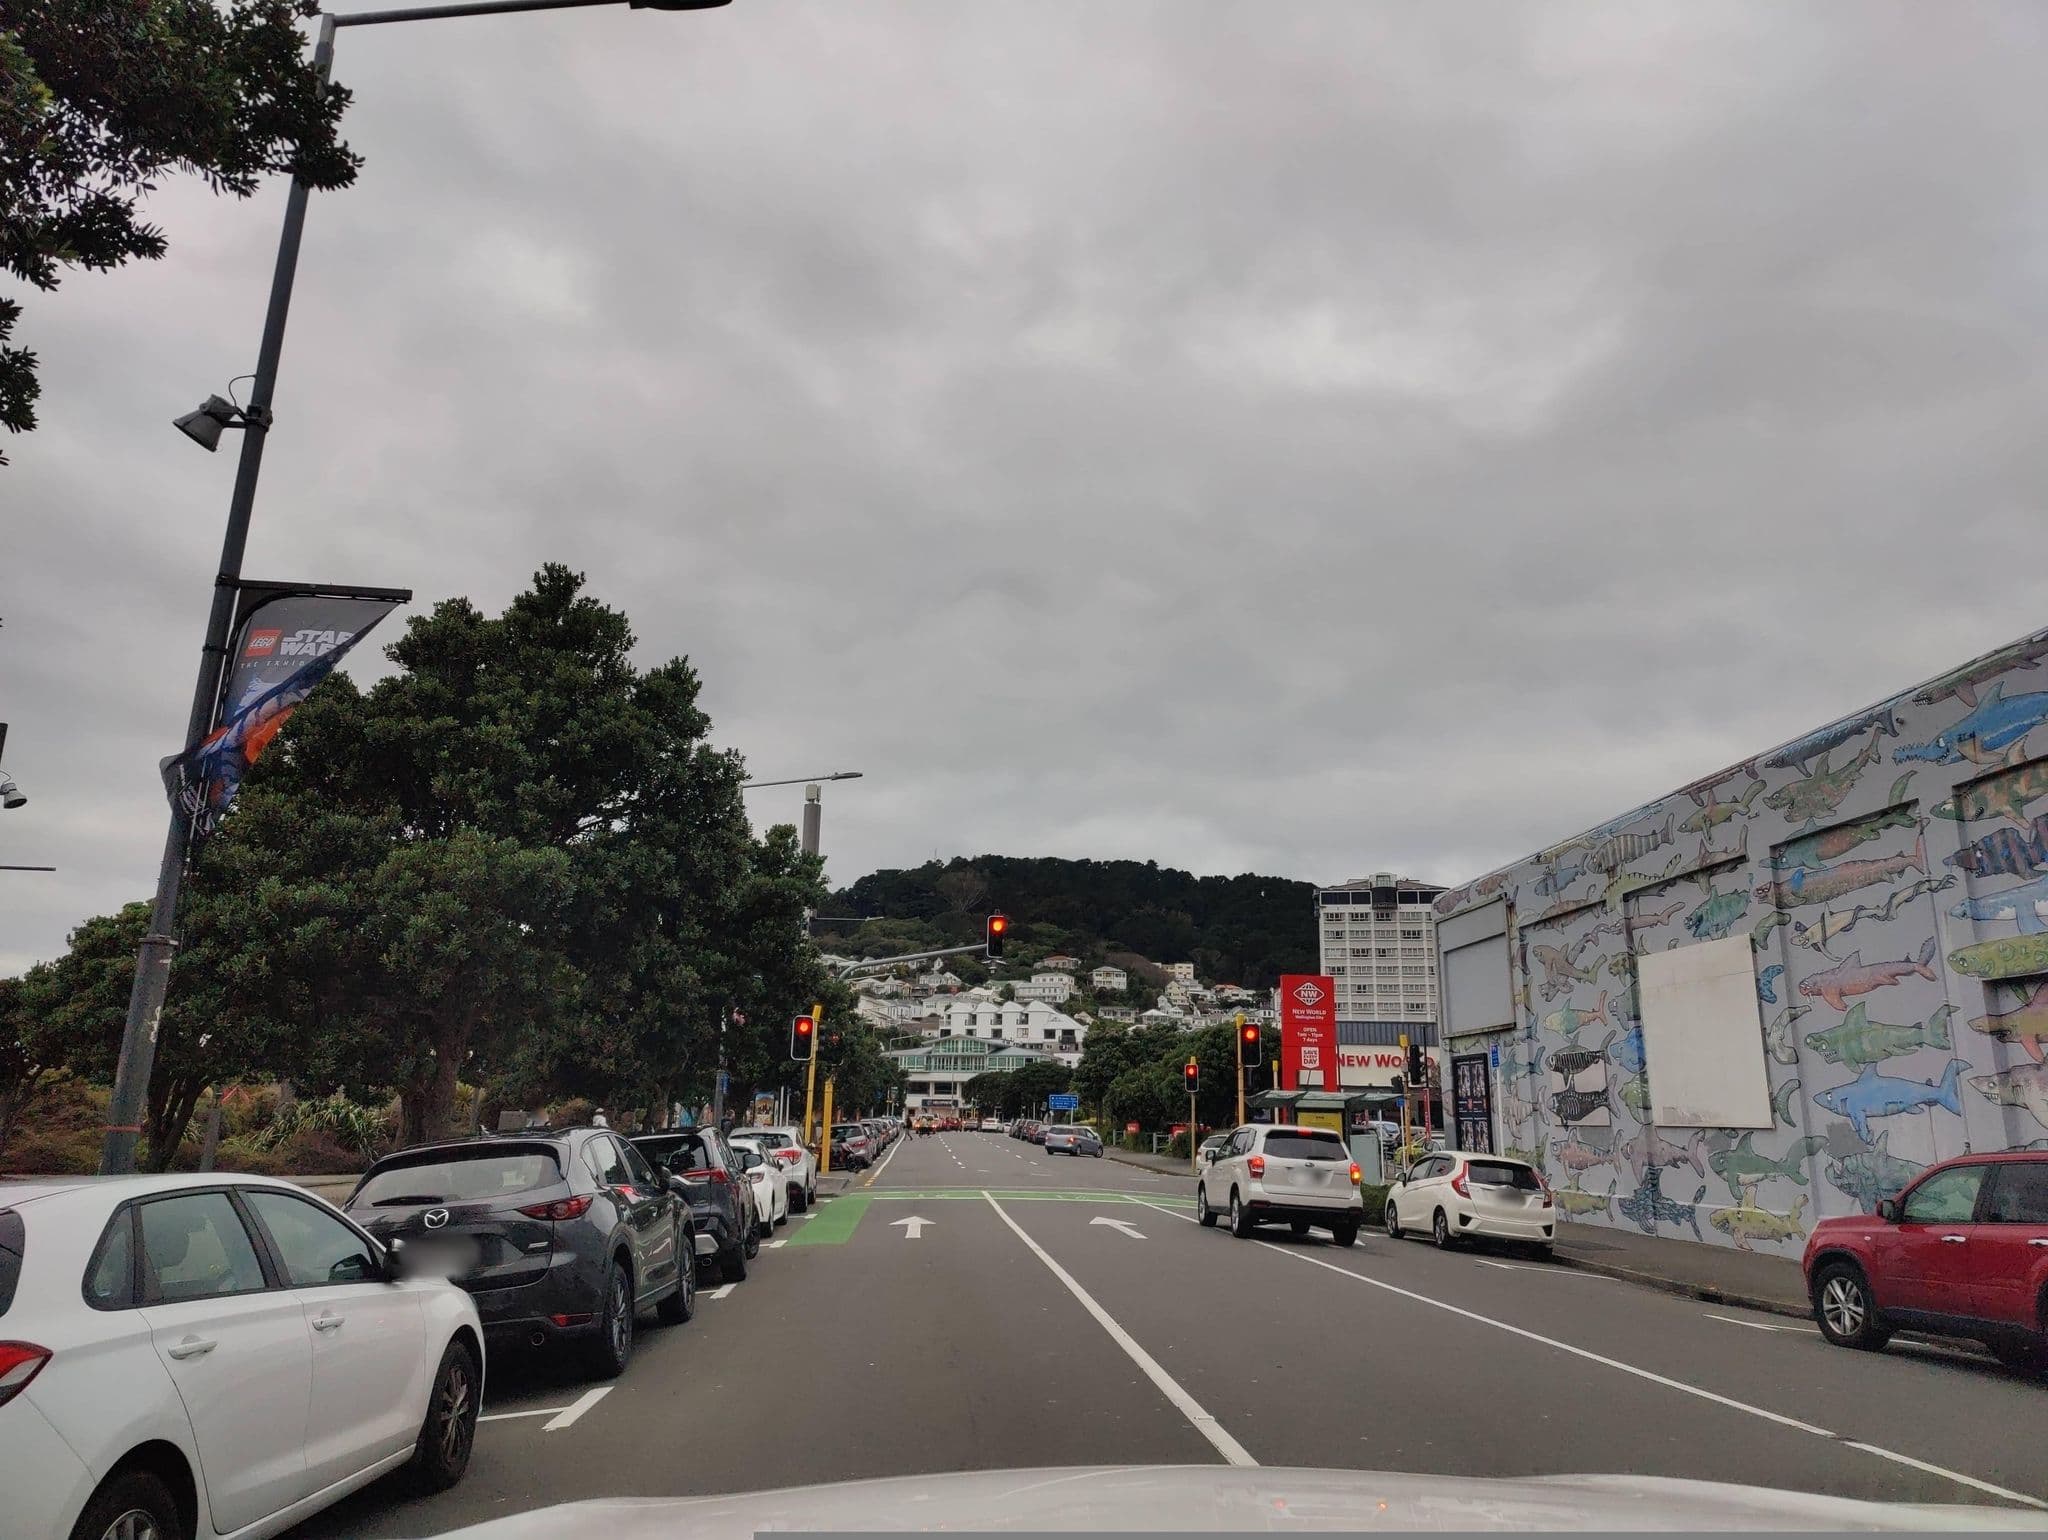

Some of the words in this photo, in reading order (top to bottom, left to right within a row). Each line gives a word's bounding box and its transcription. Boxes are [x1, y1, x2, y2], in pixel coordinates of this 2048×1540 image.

[249, 636, 277, 649] LEGO
[1300, 990, 1318, 998] NW
[1338, 1054, 1371, 1067] NEW
